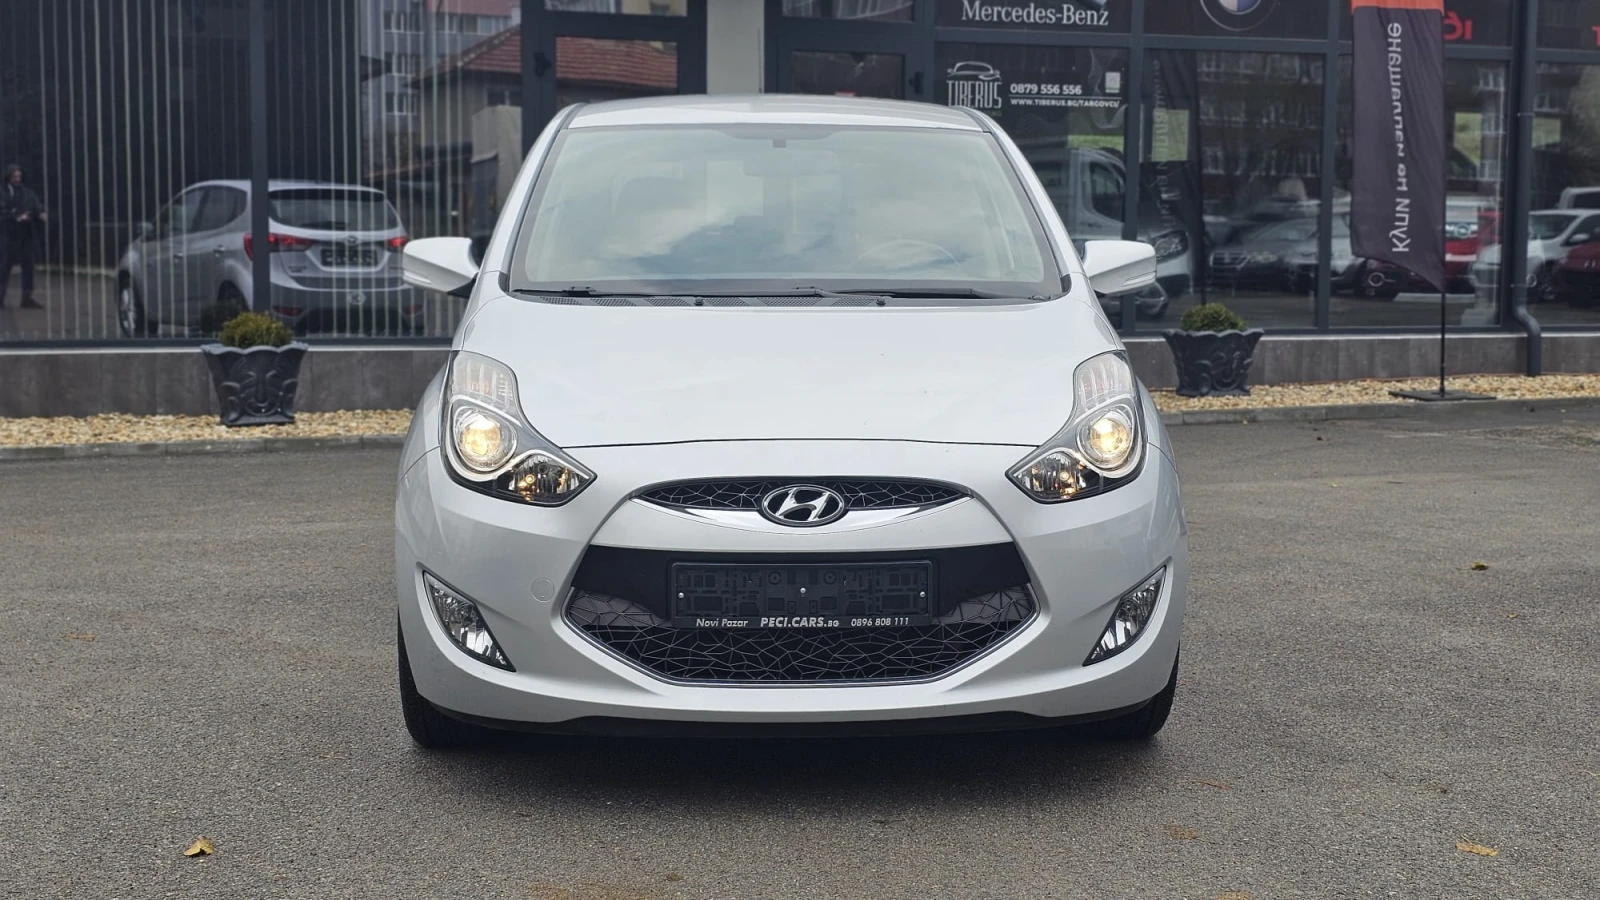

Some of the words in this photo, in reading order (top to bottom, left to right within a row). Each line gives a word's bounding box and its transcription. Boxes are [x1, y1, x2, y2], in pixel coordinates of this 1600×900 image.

[961, 0, 1109, 26] Mercedes-Benz
[946, 80, 1002, 108] TIBERUS
[1010, 83, 1038, 94] 0879
[1040, 84, 1060, 94] 556
[1062, 85, 1082, 95] 556
[696, 618, 719, 627] Novi
[721, 618, 748, 627] Pazar
[851, 618, 873, 627] 0896
[875, 617, 892, 626] 808
[894, 617, 909, 626] 111
